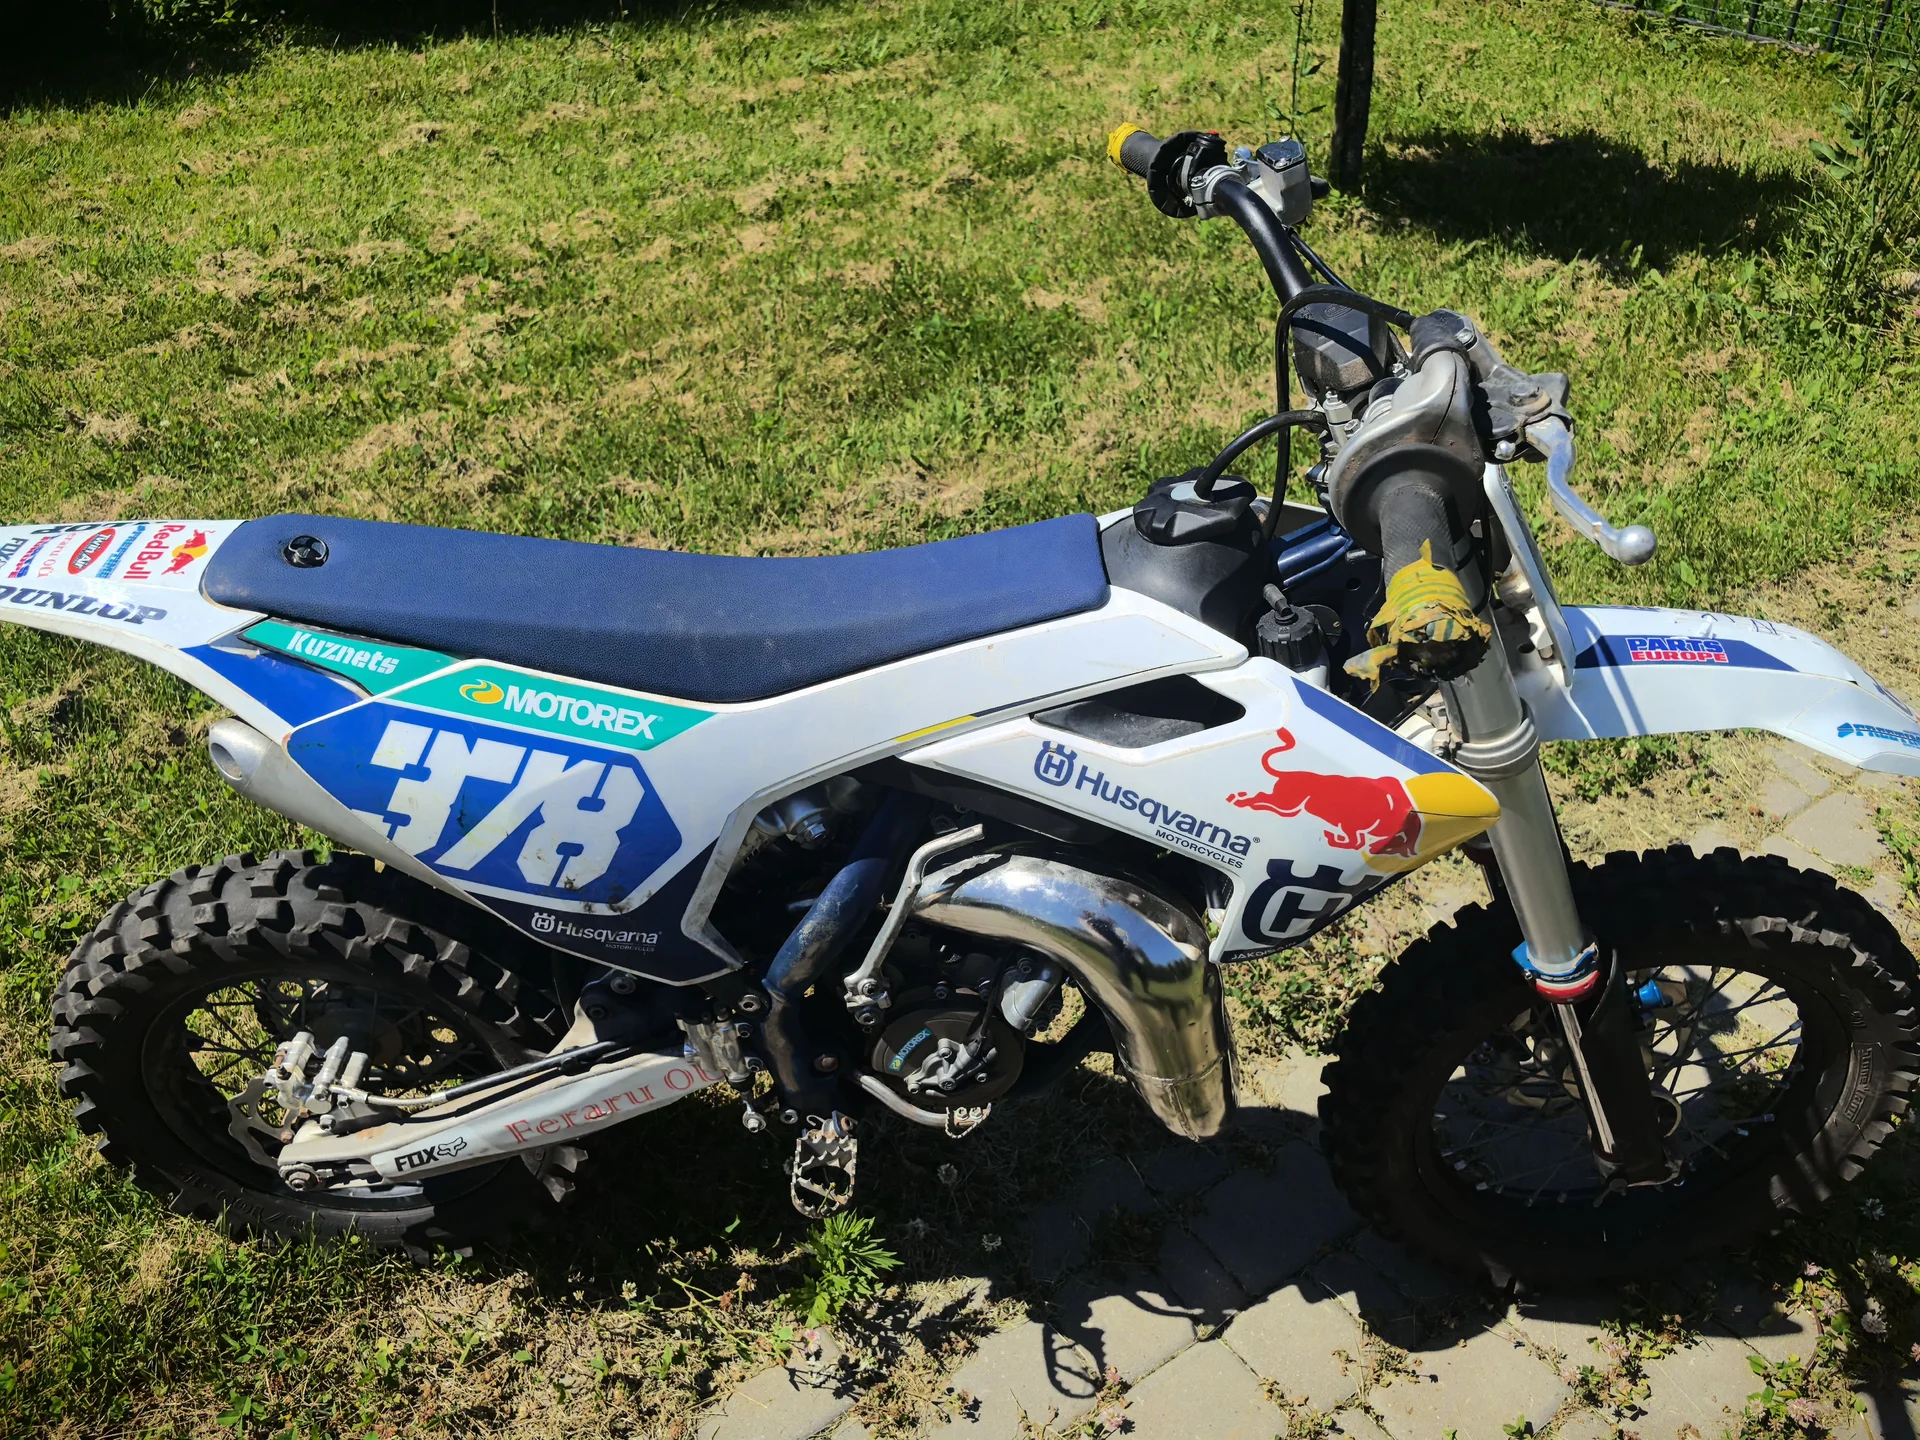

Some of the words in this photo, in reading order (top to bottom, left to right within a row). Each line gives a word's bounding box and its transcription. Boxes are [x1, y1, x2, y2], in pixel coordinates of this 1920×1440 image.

[287, 631, 399, 675] Kuznets
[1625, 638, 1724, 654] PARTS
[1631, 650, 1729, 663] EUROPE
[504, 686, 654, 740] MOTOREX
[352, 720, 646, 888] 378
[1075, 765, 1251, 857] Husqvarna
[1155, 829, 1243, 869] MOTORCYCLES
[556, 920, 658, 944] Husqvarna
[605, 943, 655, 952] MOTORCYCLES
[897, 1029, 930, 1060] MOTOREX
[505, 1084, 656, 1144] Feraru
[395, 1145, 440, 1173] FOX
